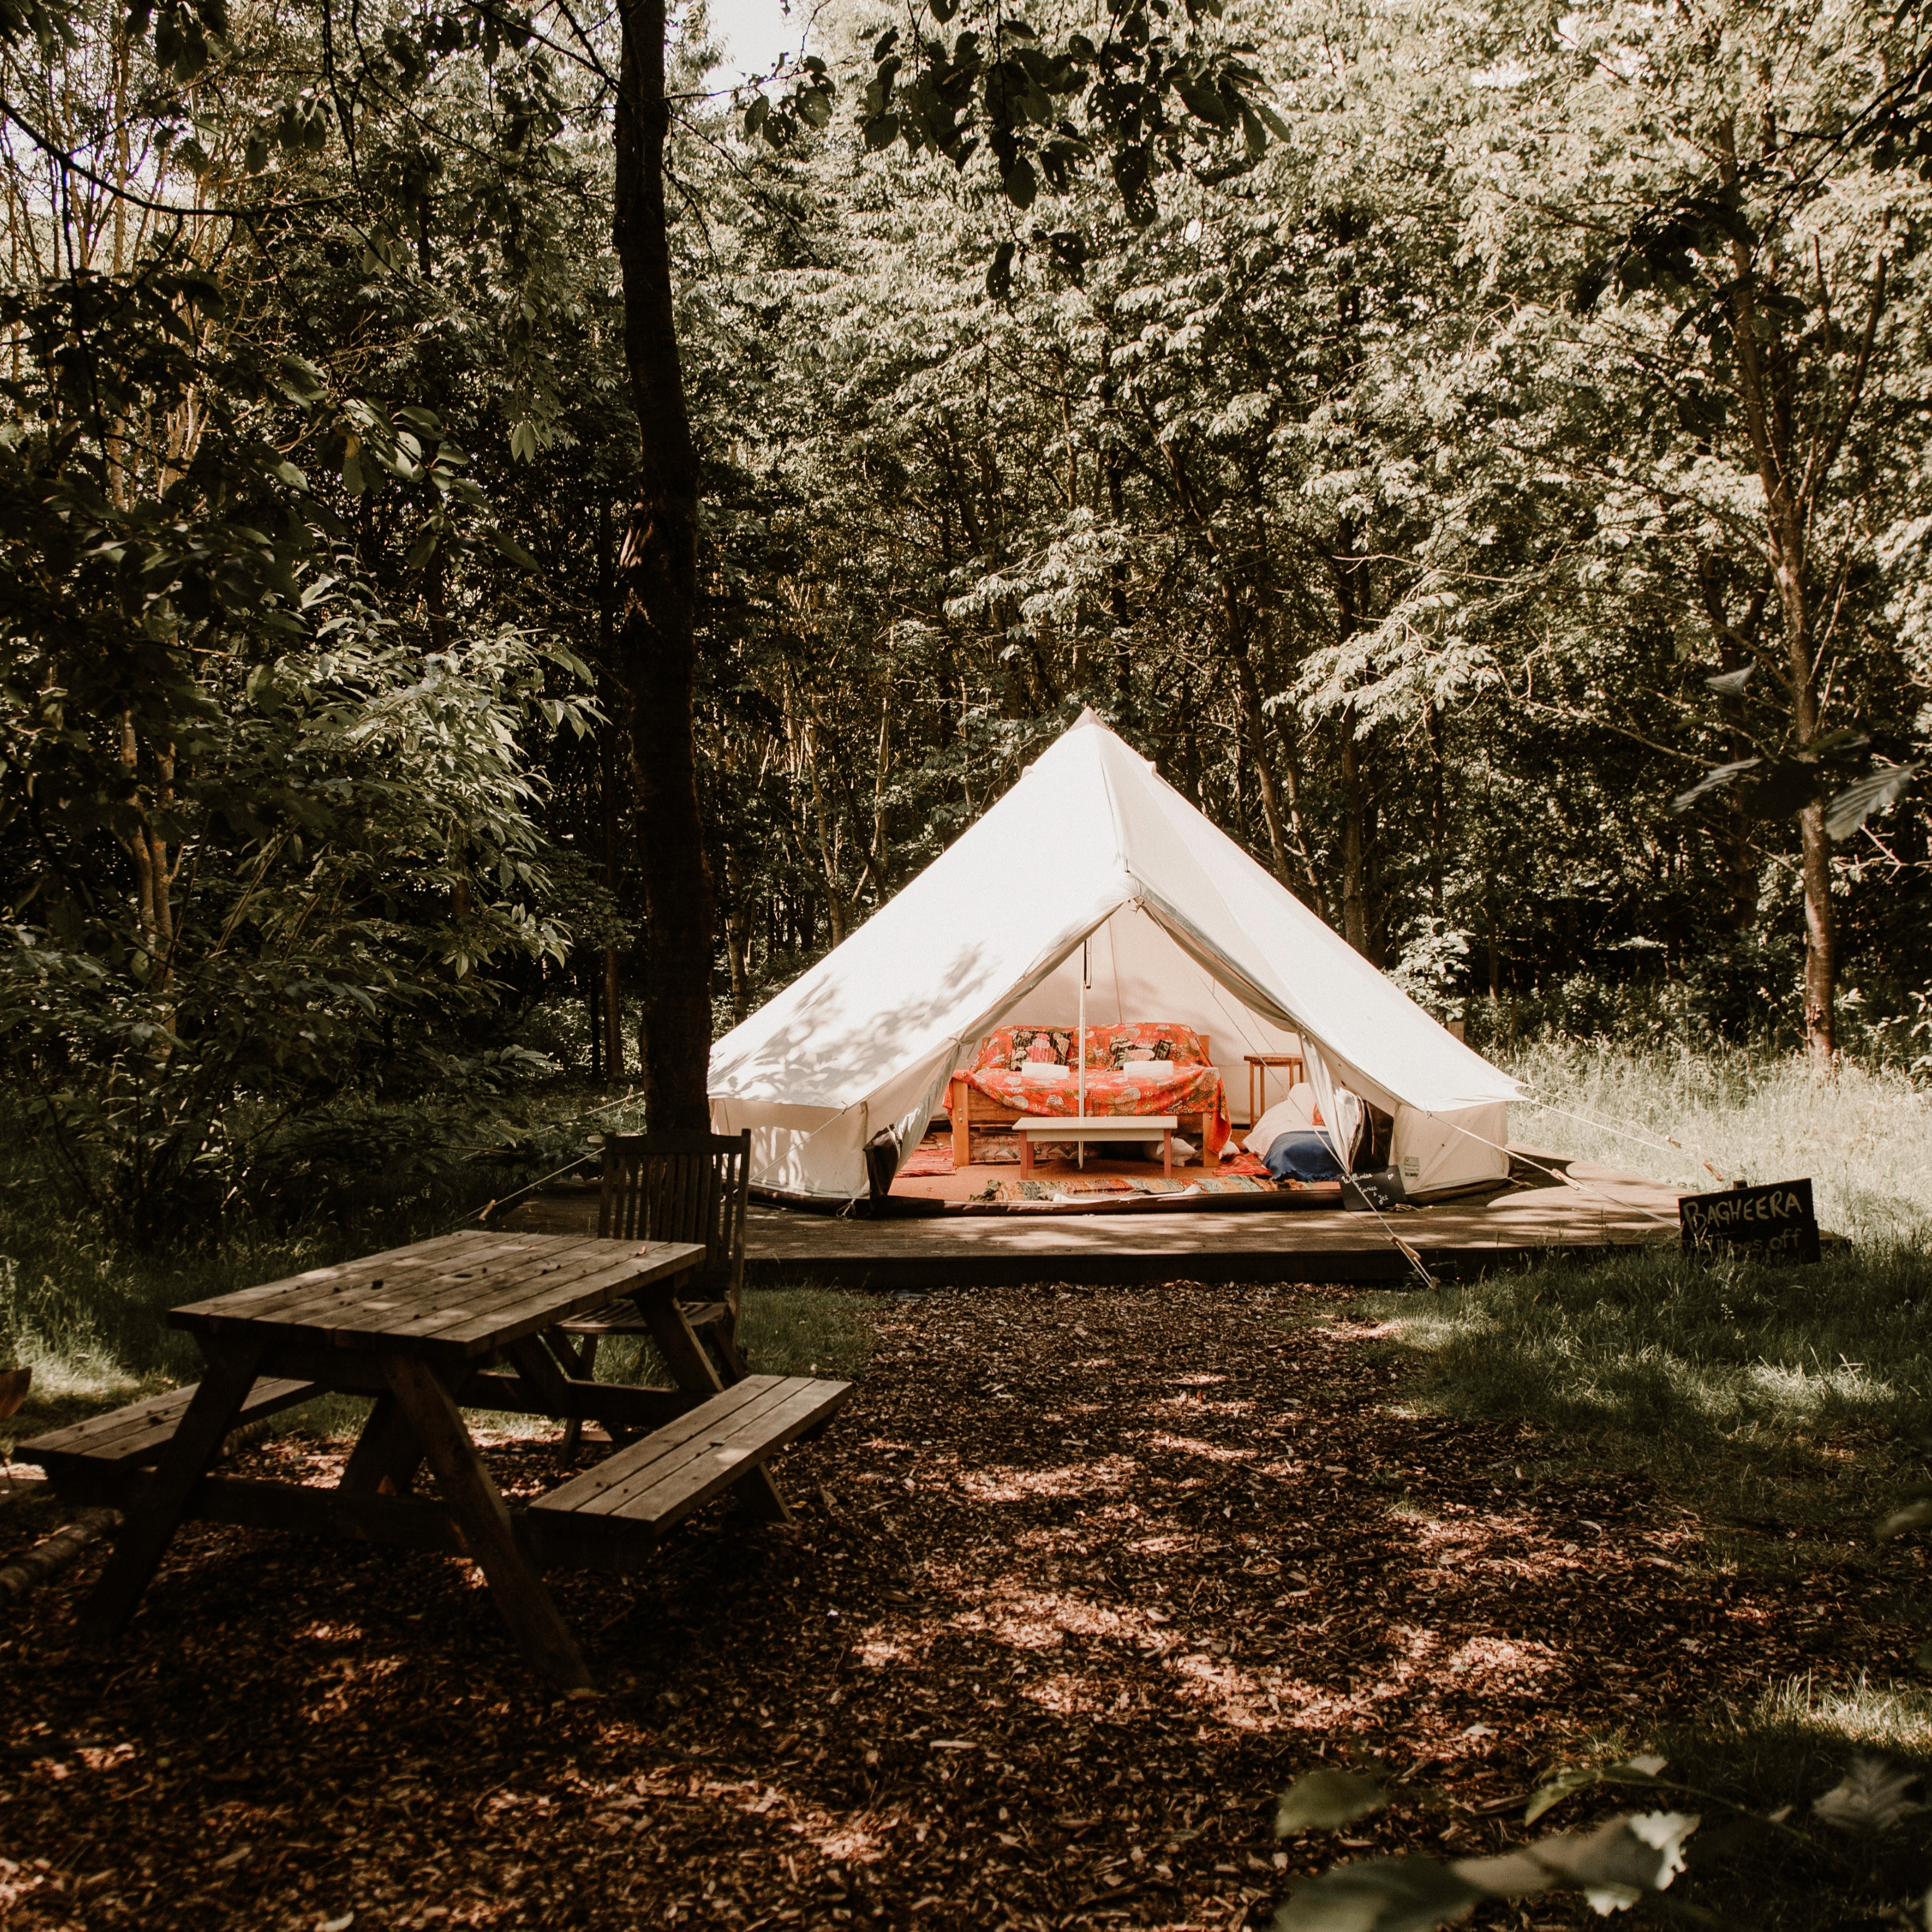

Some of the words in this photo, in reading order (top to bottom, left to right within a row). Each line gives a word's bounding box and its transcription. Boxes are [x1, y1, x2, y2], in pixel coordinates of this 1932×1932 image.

[1341, 1172, 1373, 1184] Wllemien
[1378, 1195, 1389, 1205] Jet
[1683, 1190, 1803, 1235] BAGHEERA
[1769, 1227, 1803, 1251] off
